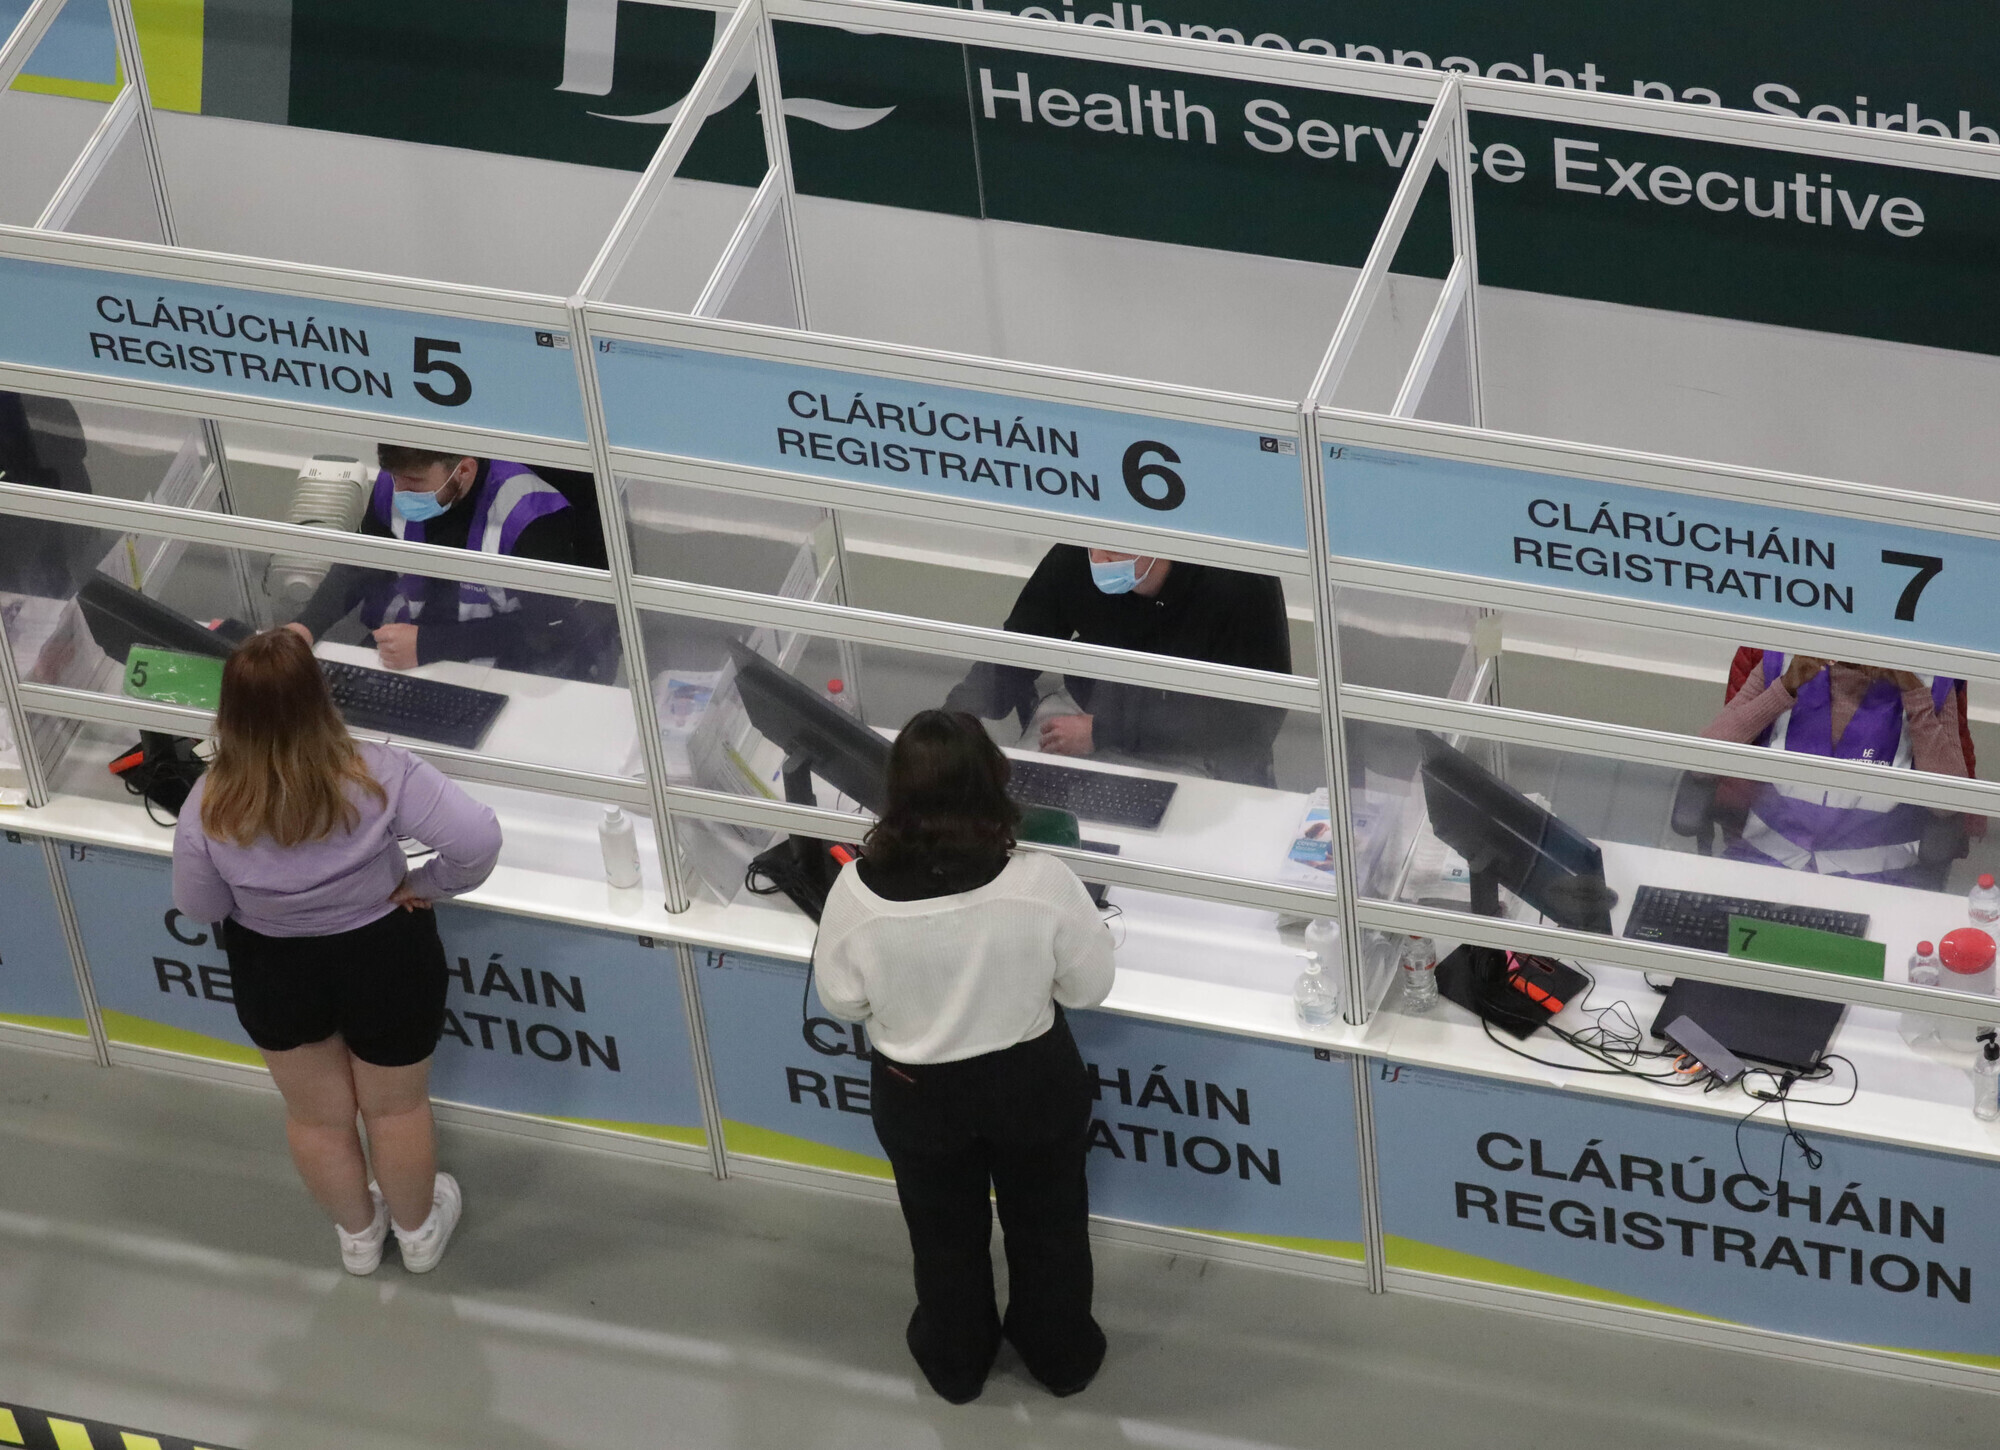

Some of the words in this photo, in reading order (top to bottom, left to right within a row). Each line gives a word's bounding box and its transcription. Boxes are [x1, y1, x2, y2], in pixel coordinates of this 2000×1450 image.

[979, 67, 1217, 144] Health
[1244, 98, 1526, 183] Serve
[1553, 136, 1925, 237] Executive
[95, 295, 371, 357] CLÁRÚCHÁIN
[88, 331, 393, 399] REGISTRATION
[412, 336, 473, 407] 5
[786, 389, 1079, 459] CLÁRÚCHÁIN
[776, 427, 1101, 501] REGISTRATION
[1121, 439, 1187, 511] 6
[1527, 498, 1835, 570] CLÁRÚCHÁIN
[1512, 536, 1854, 614] REGISTRATION
[1880, 549, 1944, 623] 7
[130, 660, 149, 688] 5
[1738, 927, 1758, 952] 7
[785, 1066, 1282, 1186] REATION
[1475, 1131, 1945, 1244] CLÁRÚCHÁIN
[1454, 1181, 1972, 1304] REGISTRATION
